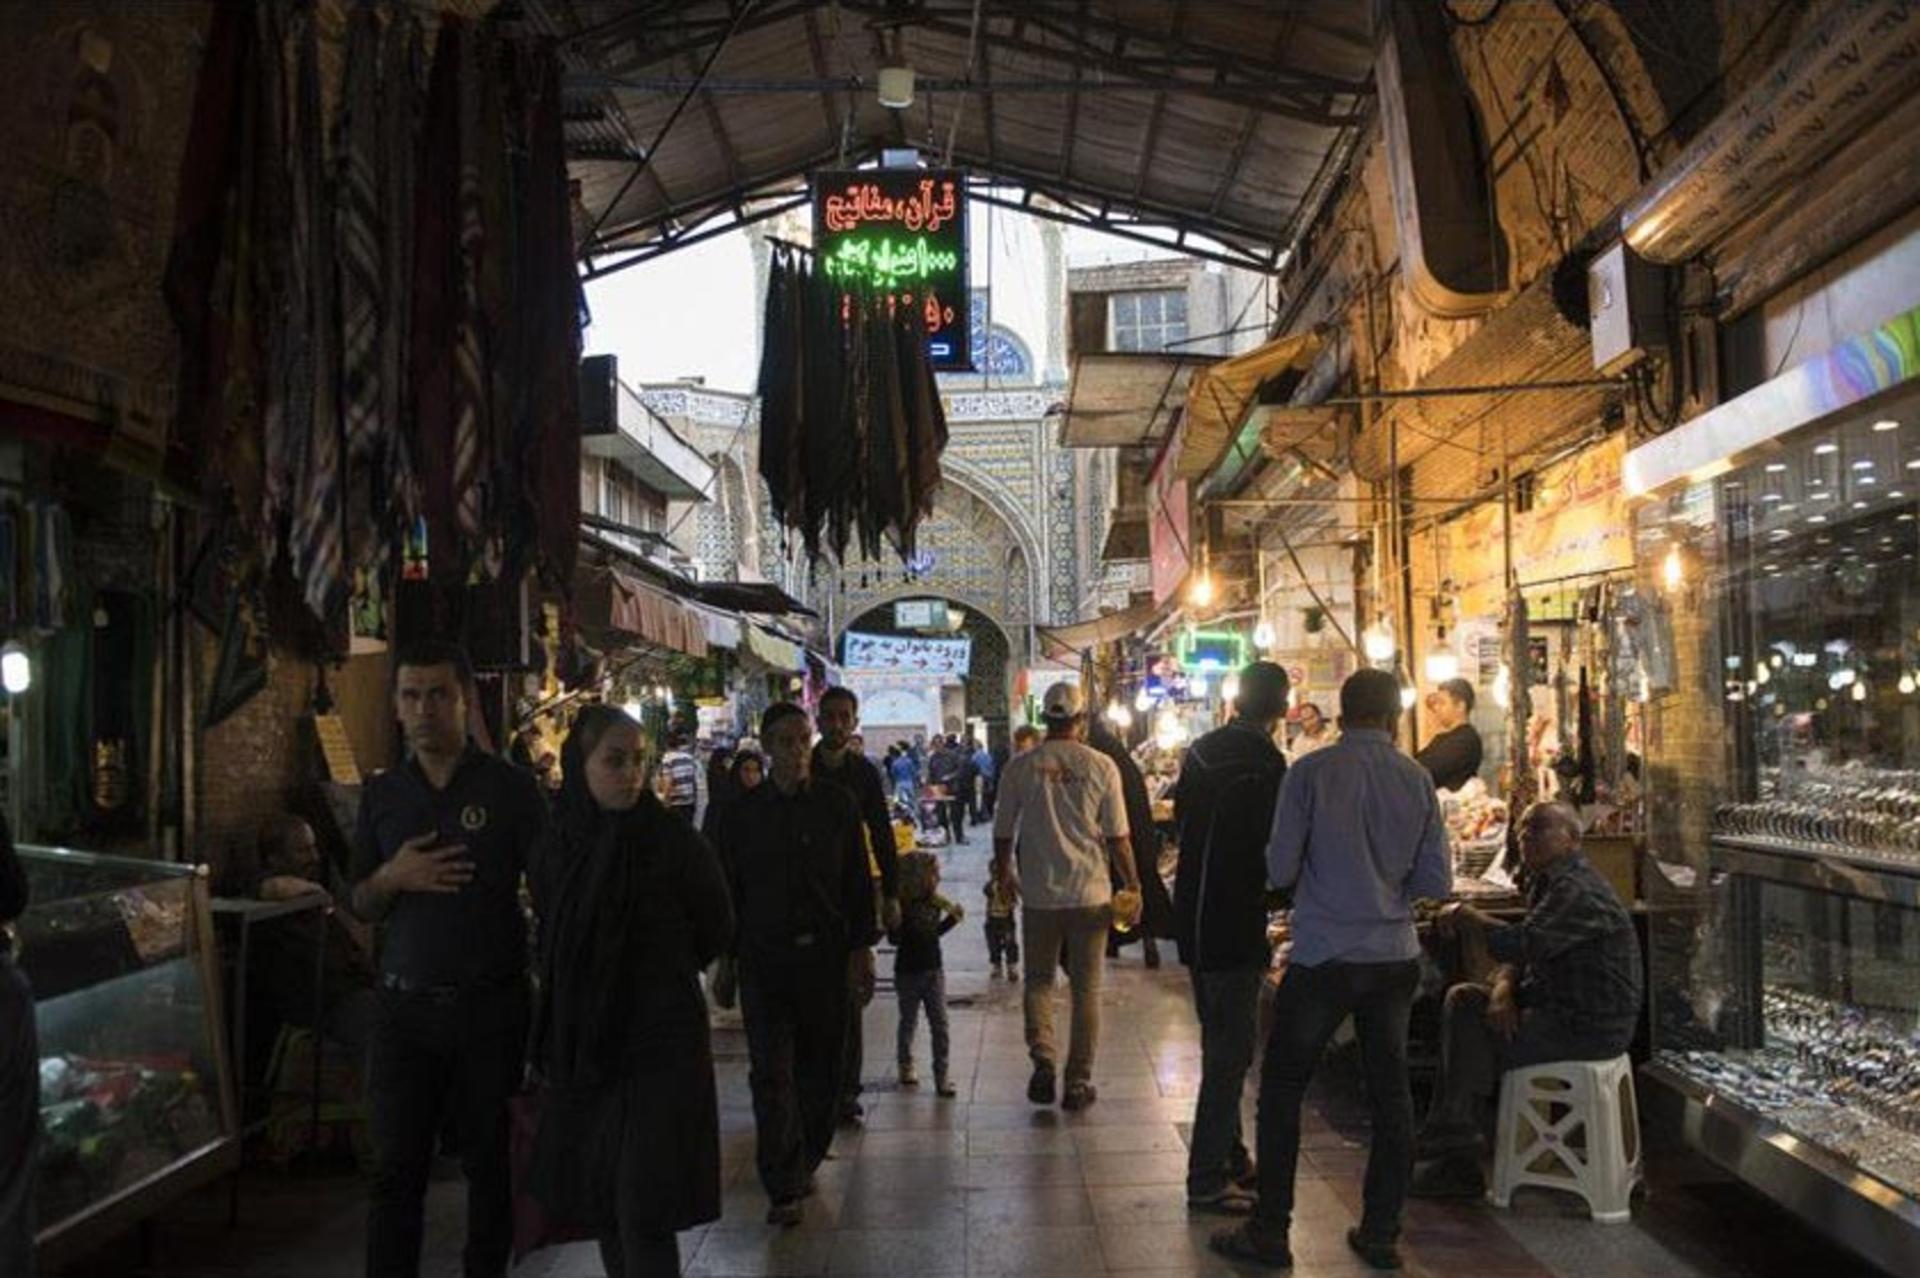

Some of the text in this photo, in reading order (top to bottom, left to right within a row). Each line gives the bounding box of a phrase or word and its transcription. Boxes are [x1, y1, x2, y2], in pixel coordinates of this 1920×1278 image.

[826, 183, 893, 231] مفاتیح
[894, 639, 933, 655] بانوان
[934, 643, 967, 660] ورود
